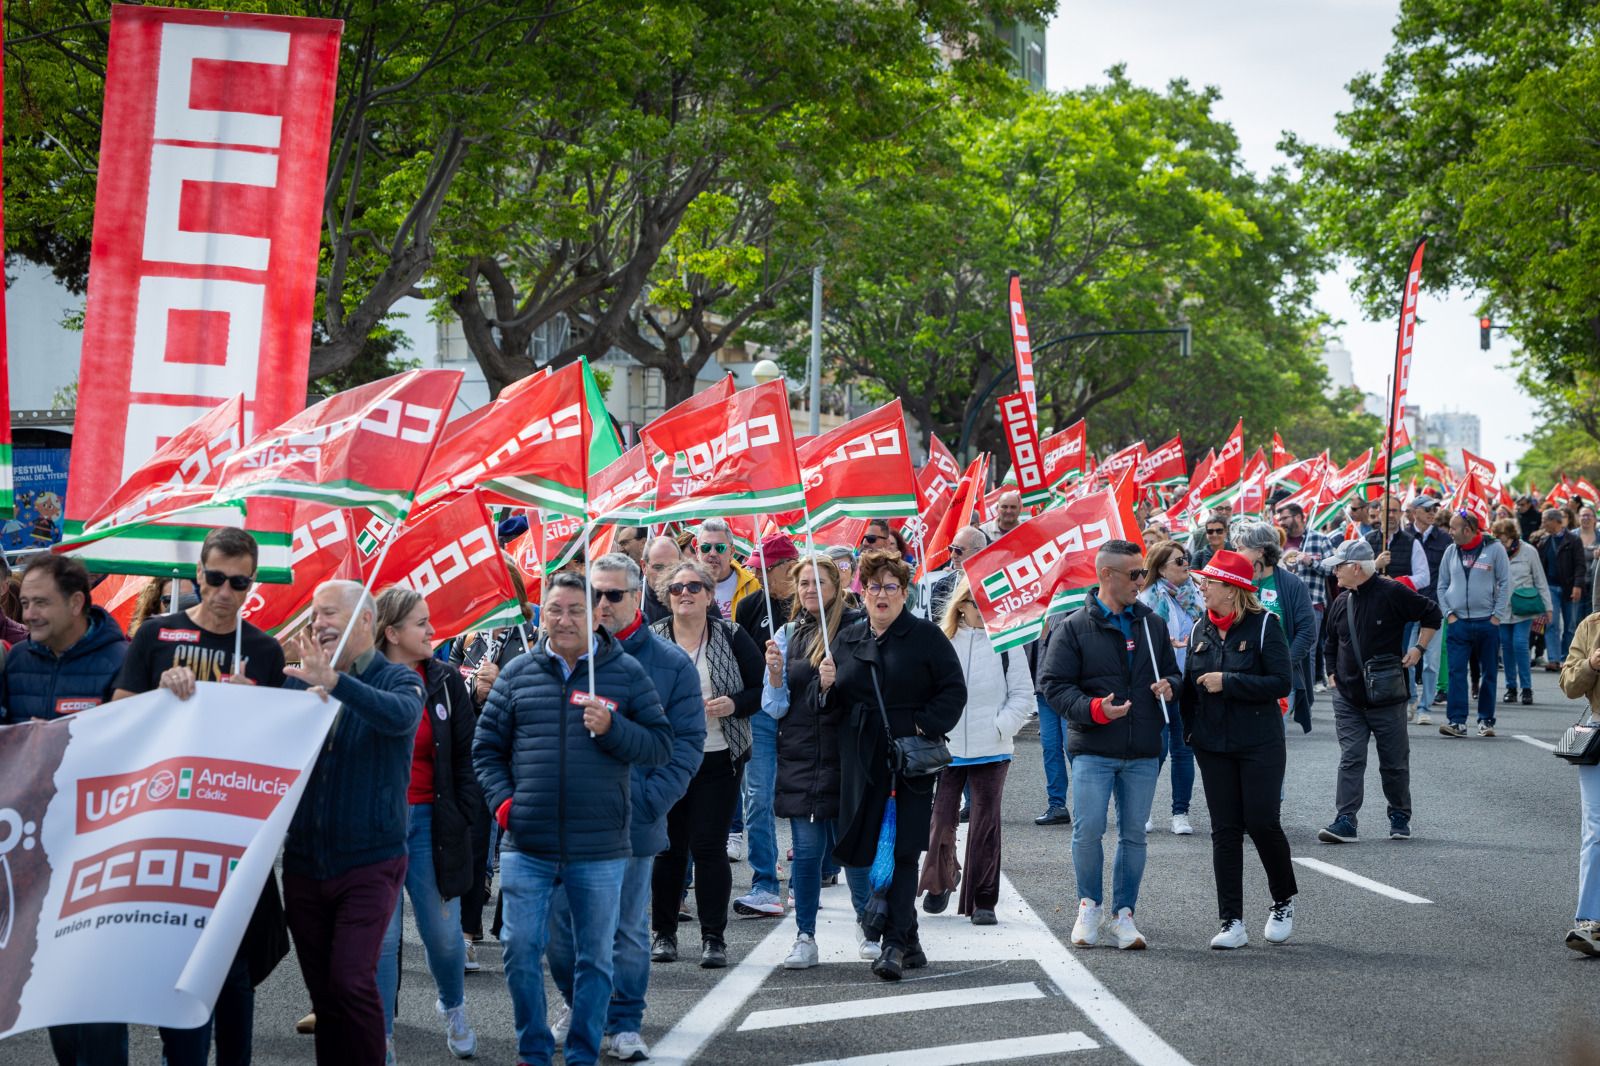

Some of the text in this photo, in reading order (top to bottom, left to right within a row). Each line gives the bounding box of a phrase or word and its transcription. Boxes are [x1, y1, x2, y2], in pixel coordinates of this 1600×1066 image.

[1011, 301, 1037, 432] CCO
[1004, 399, 1041, 488] CCOO
[14, 464, 53, 474] FESTIVAL
[160, 631, 191, 641] CCOO
[61, 702, 88, 710] CCOO
[196, 787, 228, 801] Cádiz
[197, 768, 290, 797] Andalucía
[86, 778, 148, 821] UGT
[70, 850, 223, 902] CCOO
[54, 910, 208, 938] unión provincial d
